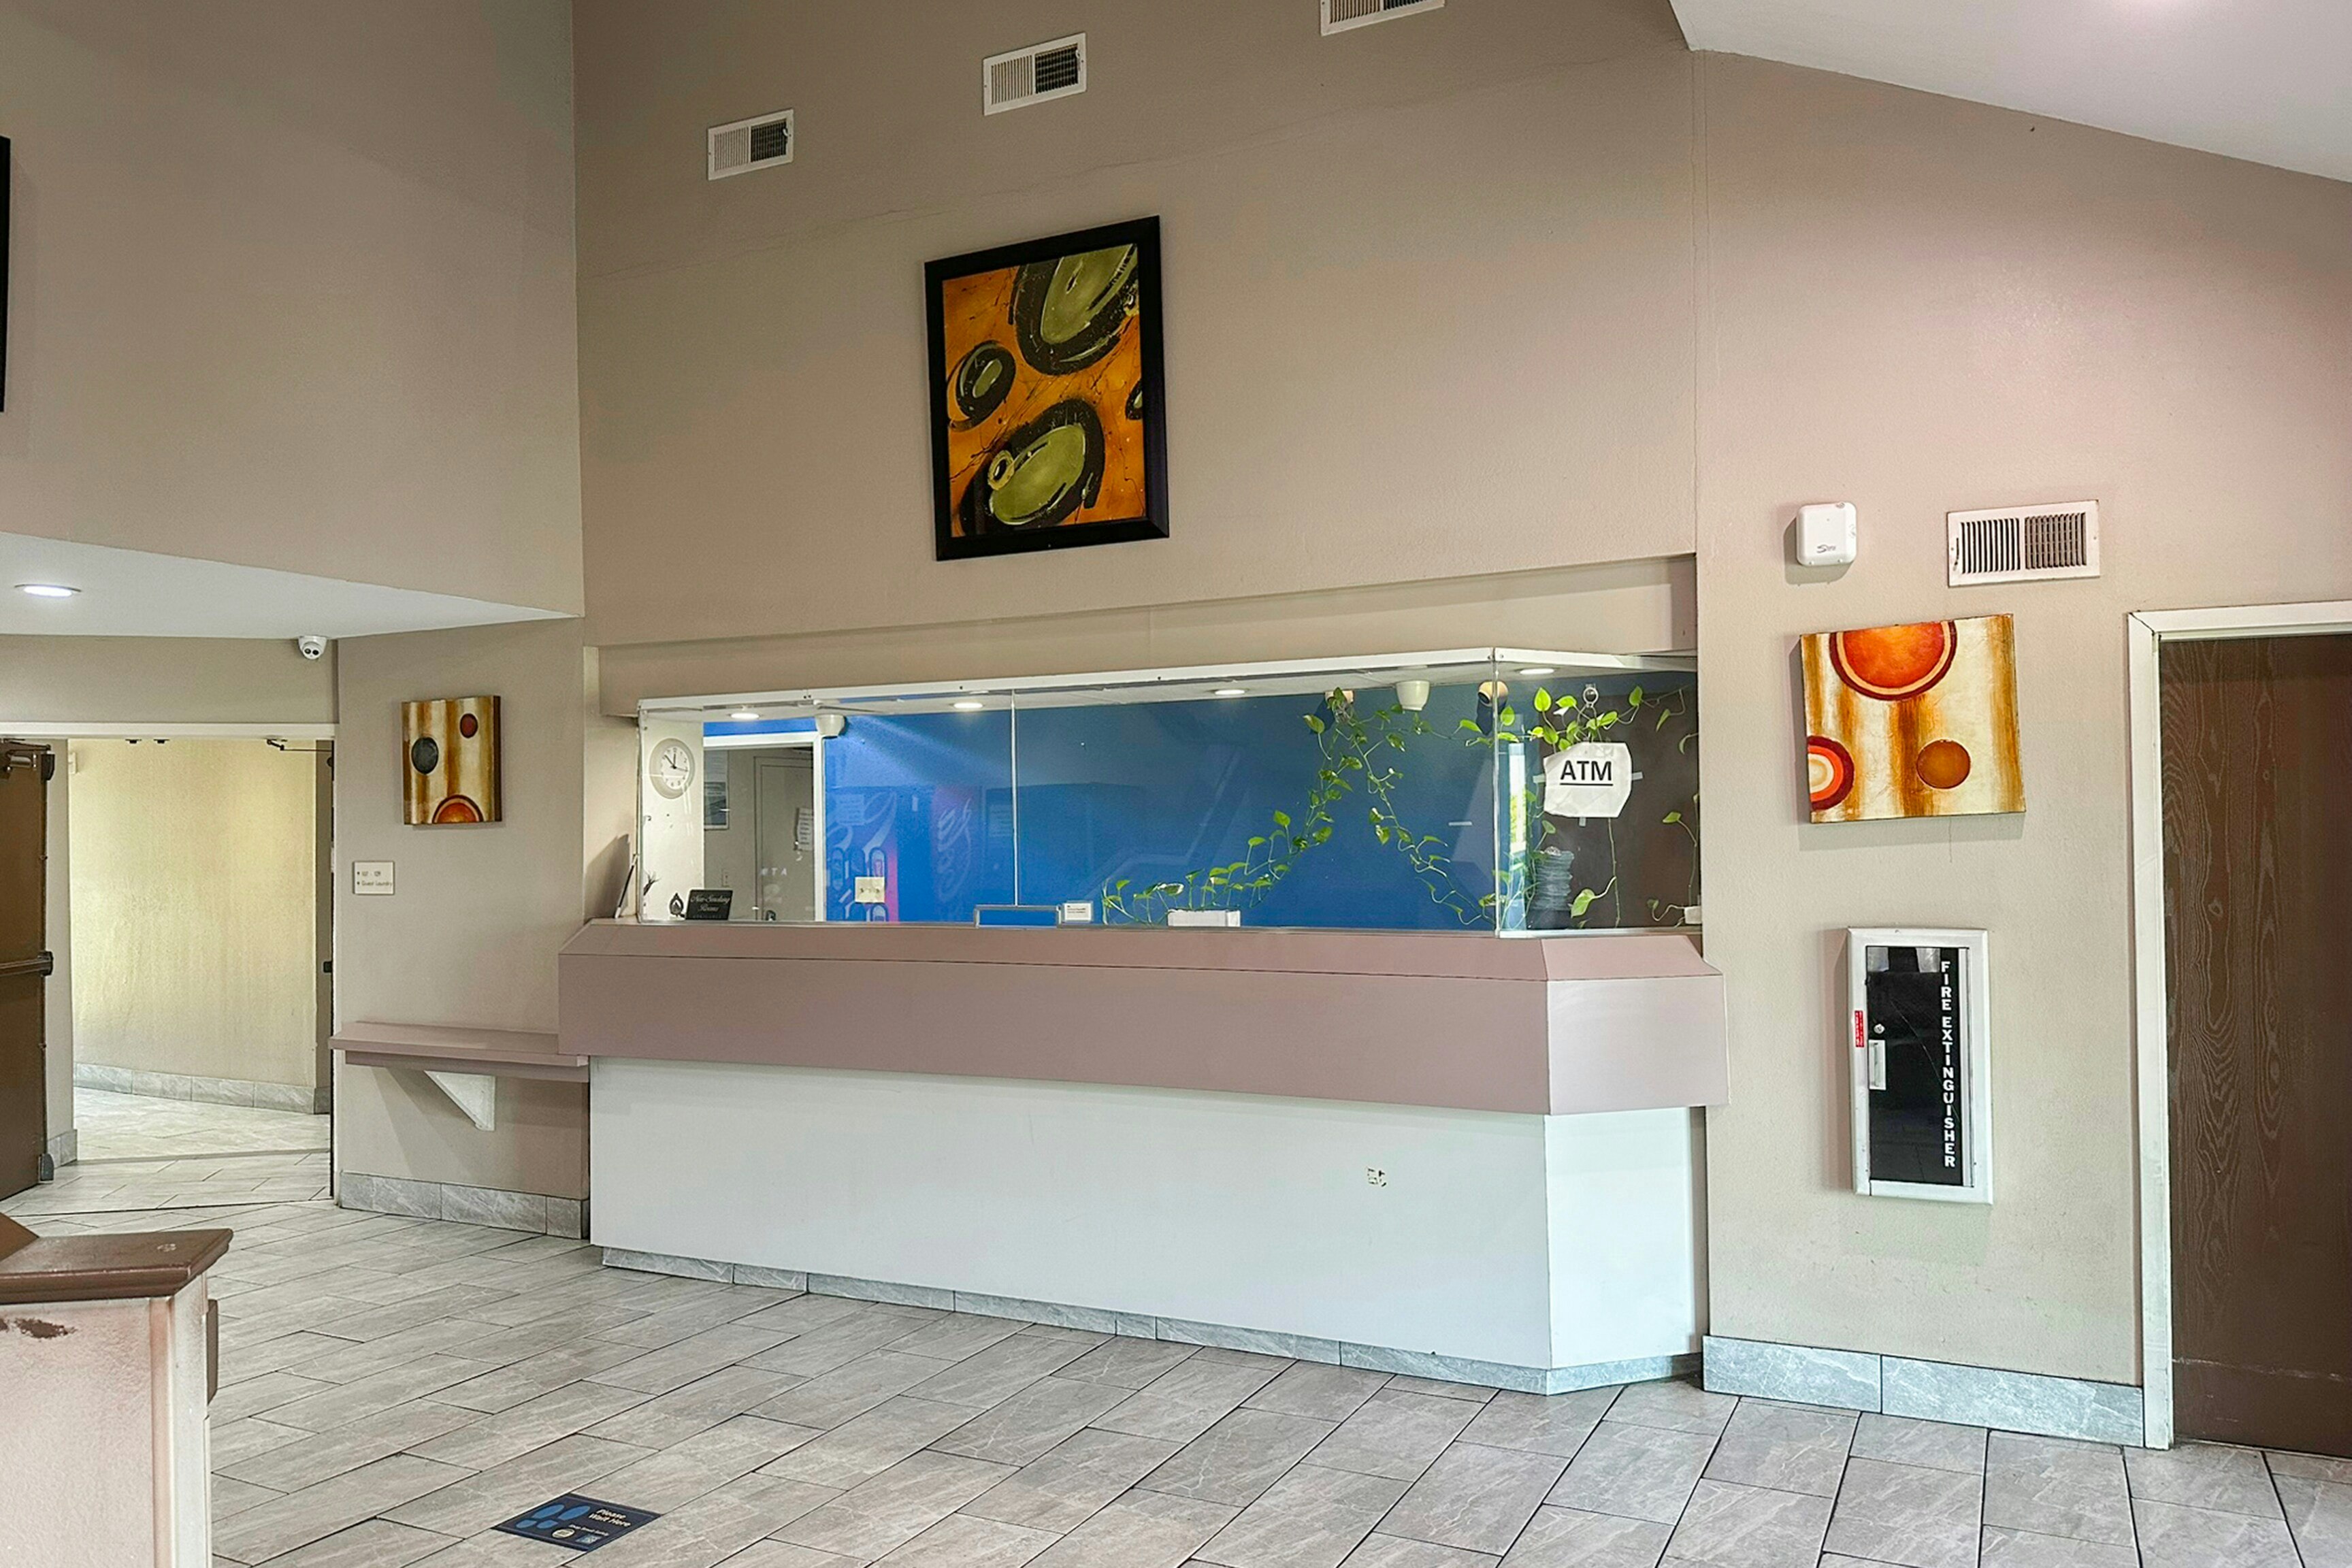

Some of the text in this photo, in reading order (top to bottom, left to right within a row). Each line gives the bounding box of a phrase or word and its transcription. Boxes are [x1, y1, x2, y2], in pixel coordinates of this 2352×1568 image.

[1560, 760, 1612, 781] ATM
[1940, 961, 1956, 1168] FIRE EXTINGUISHER
